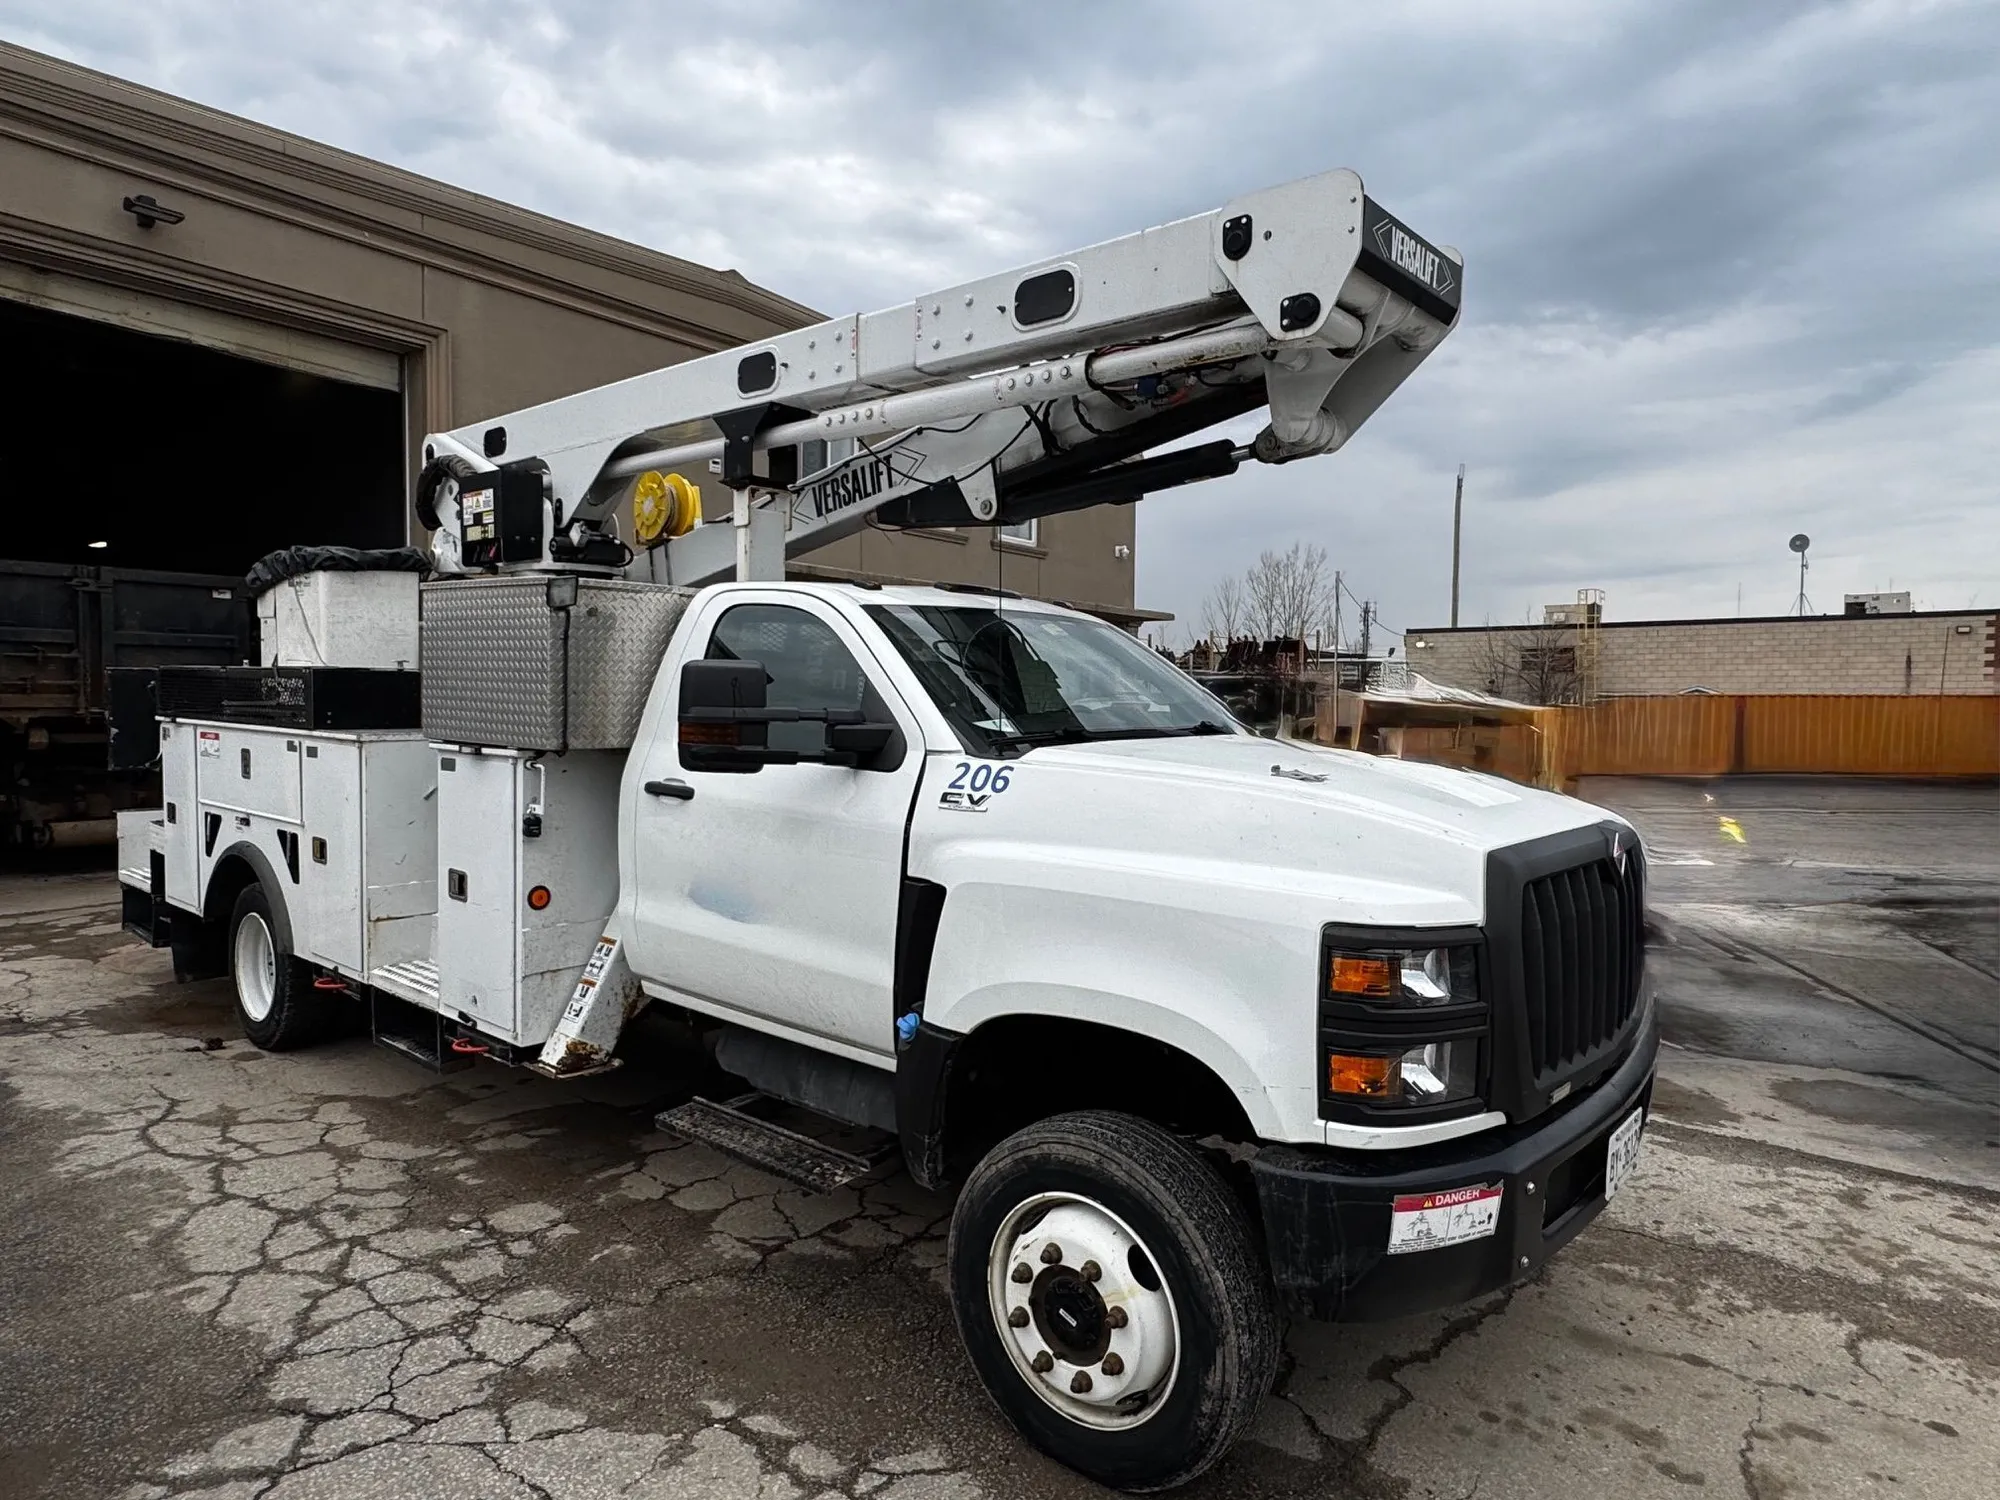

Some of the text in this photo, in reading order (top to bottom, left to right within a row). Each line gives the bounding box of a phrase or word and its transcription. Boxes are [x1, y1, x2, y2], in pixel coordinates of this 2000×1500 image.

[1391, 225, 1440, 289] VERSALIFT
[812, 454, 893, 518] VERSALIFT
[948, 762, 1015, 793] 206
[1435, 1189, 1480, 1206] DANGER
